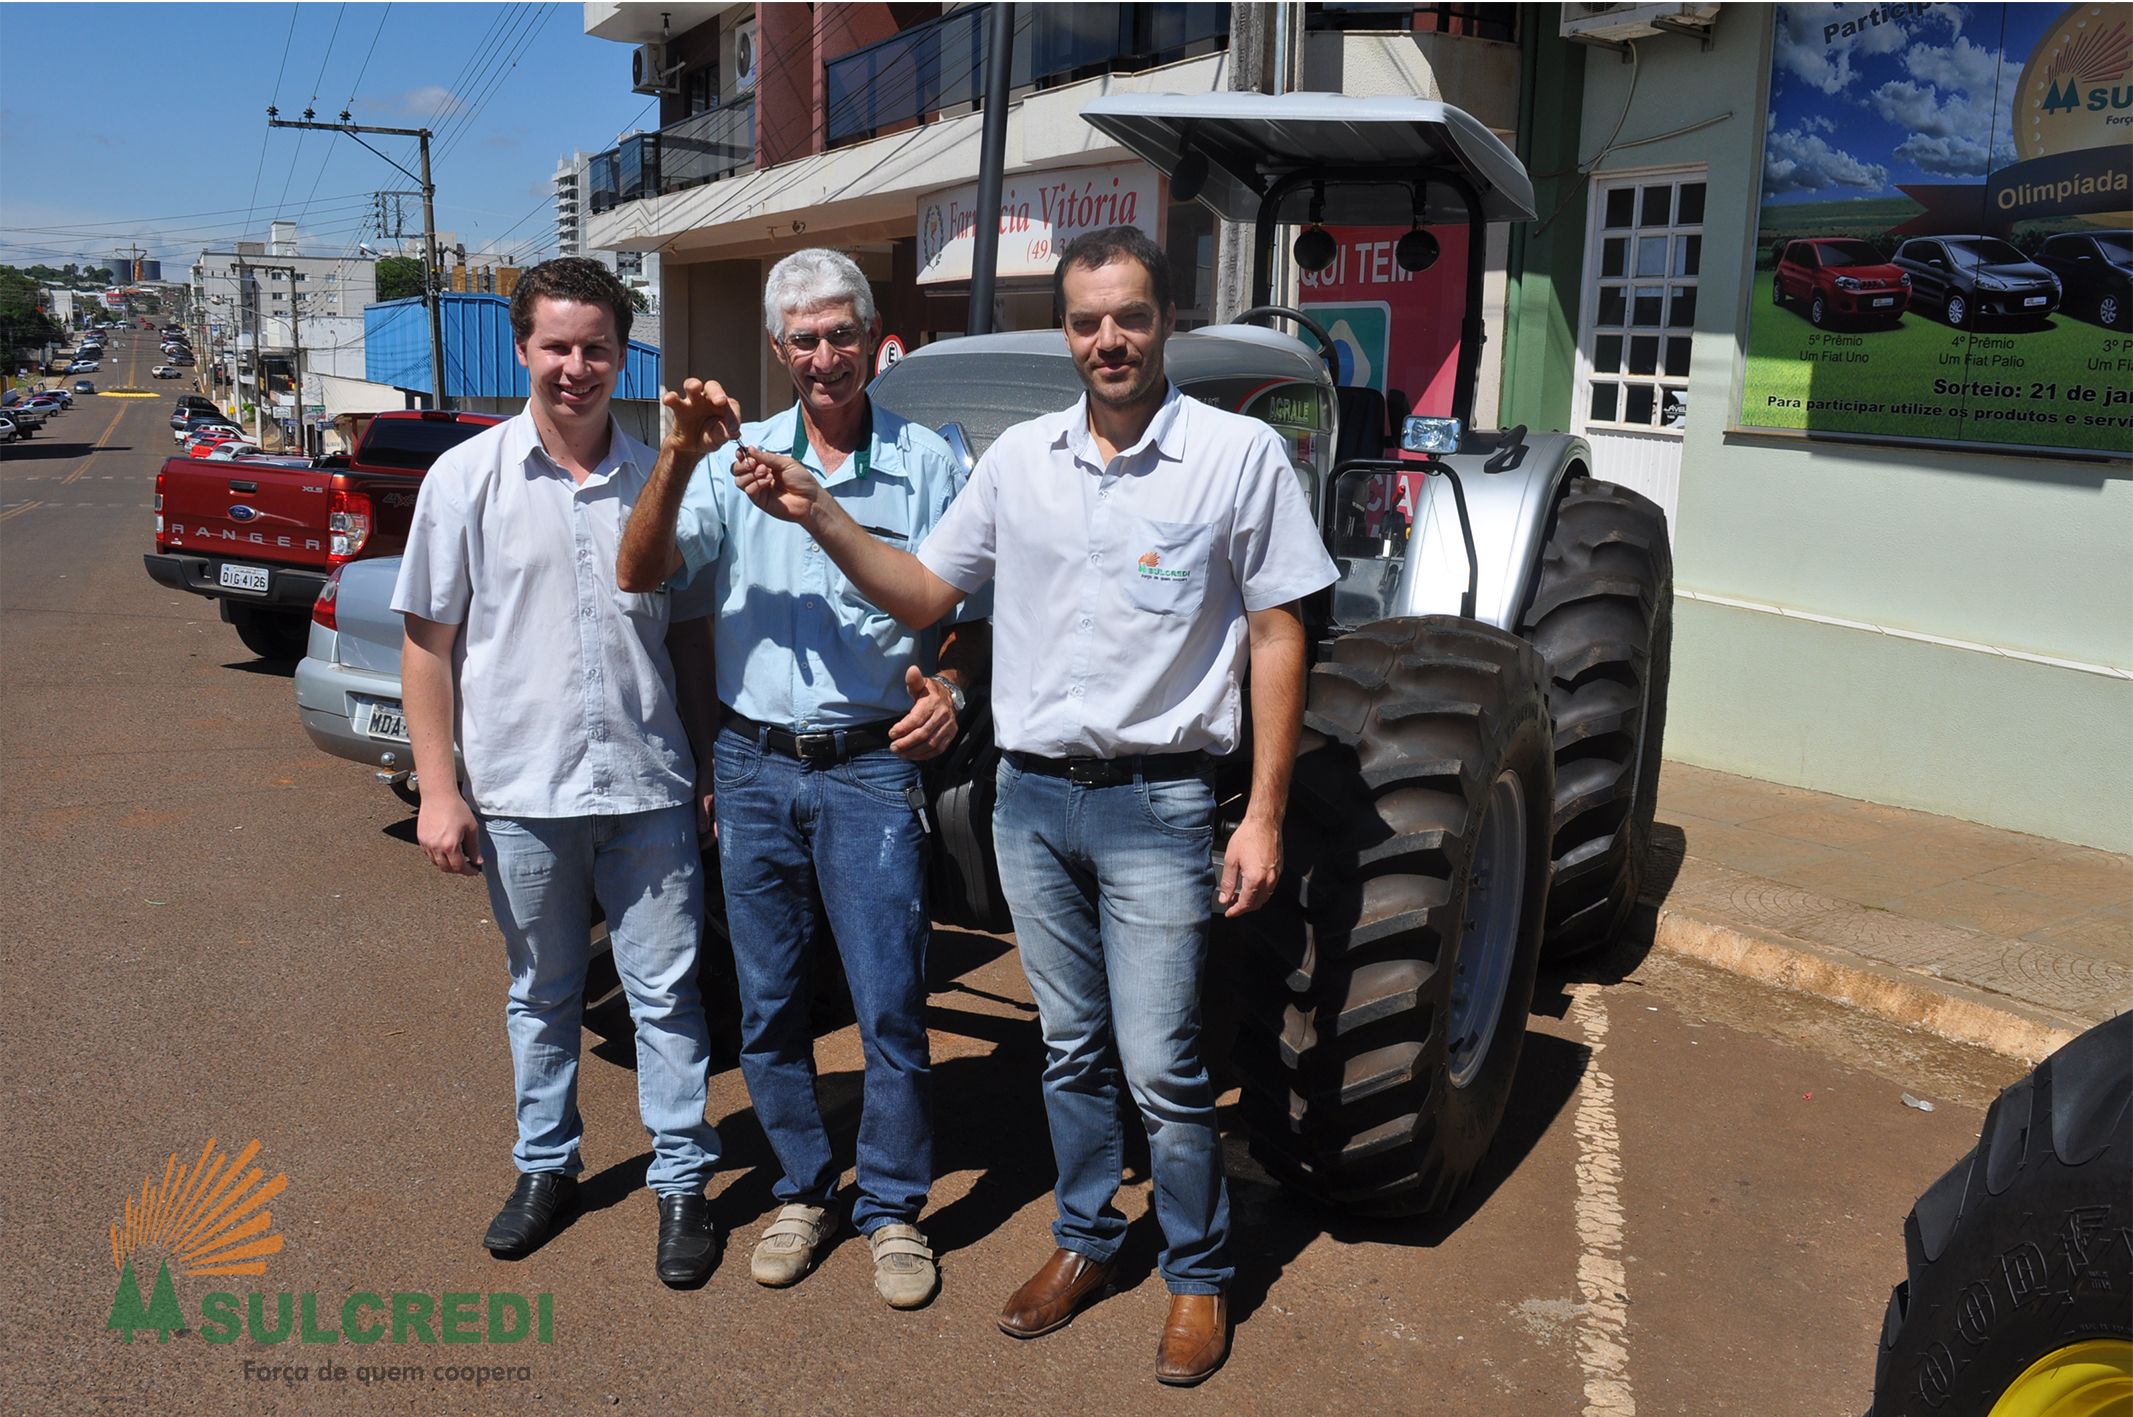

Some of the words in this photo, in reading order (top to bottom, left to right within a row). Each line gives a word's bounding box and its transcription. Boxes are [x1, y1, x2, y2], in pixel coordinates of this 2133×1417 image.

[1823, 2, 1947, 45] Particip
[1997, 169, 2128, 210] Olimpíada
[948, 189, 1031, 242] Farcia
[1039, 177, 1138, 230] Vitória
[1027, 238, 1054, 264] (49)
[1823, 335, 1863, 347] Prêmio
[1969, 336, 2015, 349] Prêmio
[1800, 350, 1819, 362] Um
[1822, 351, 1843, 363] Fiat
[1846, 351, 1869, 363] Uno
[1939, 353, 1960, 365] Um
[1964, 354, 1988, 366] Fiat
[1992, 355, 2025, 367] Palio
[2088, 358, 2112, 371] Um
[1933, 378, 2022, 399] Sorteio:
[2029, 382, 2057, 400] 21
[2066, 384, 2097, 402] de
[1268, 396, 1310, 424] AGRALE
[1767, 396, 1801, 408] Para
[1806, 399, 1886, 413] participar
[1890, 403, 1943, 416] utilize
[1948, 408, 1969, 418] os
[1974, 409, 2058, 423] produtos
[2065, 414, 2077, 424] e
[302, 485, 323, 494] XLS
[171, 523, 320, 550] RANGER
[1148, 567, 1190, 577] SULCREDI
[369, 712, 408, 738] MDA-
